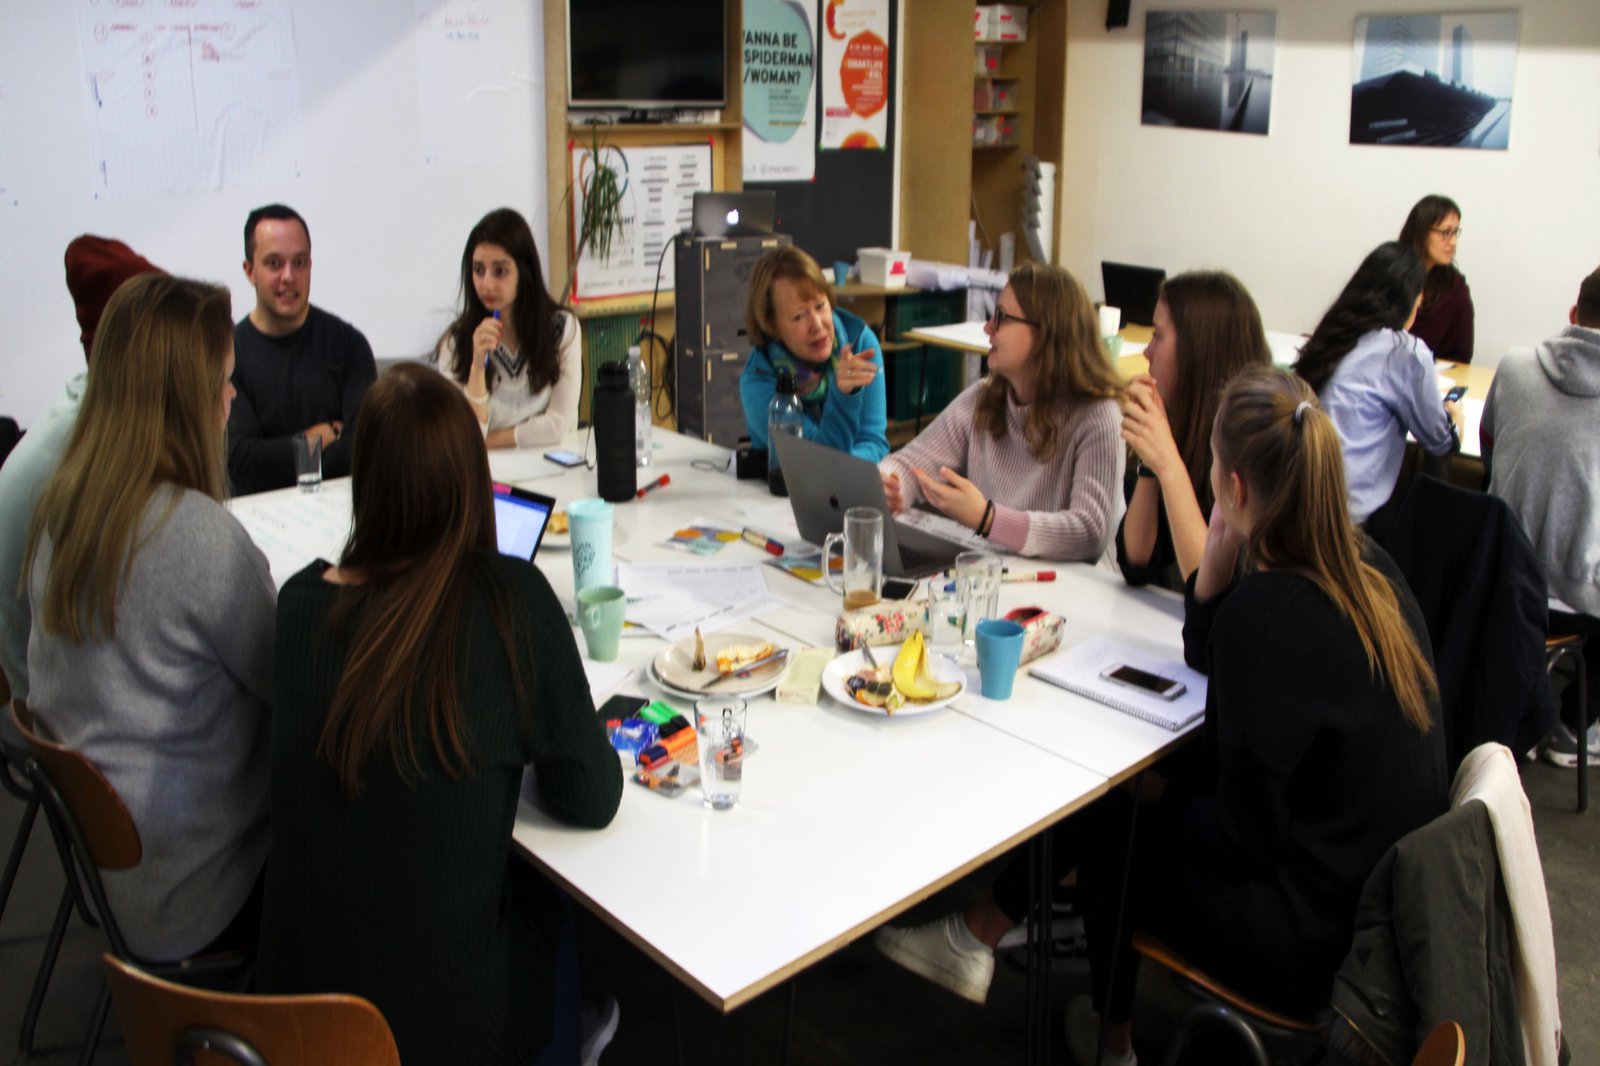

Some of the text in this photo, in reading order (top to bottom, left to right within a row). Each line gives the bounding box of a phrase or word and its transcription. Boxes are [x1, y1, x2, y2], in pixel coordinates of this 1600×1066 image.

[743, 31, 798, 48] ANNA BE
[744, 50, 812, 67] SPIDERMAN
[743, 69, 801, 85] /WOMAN?
